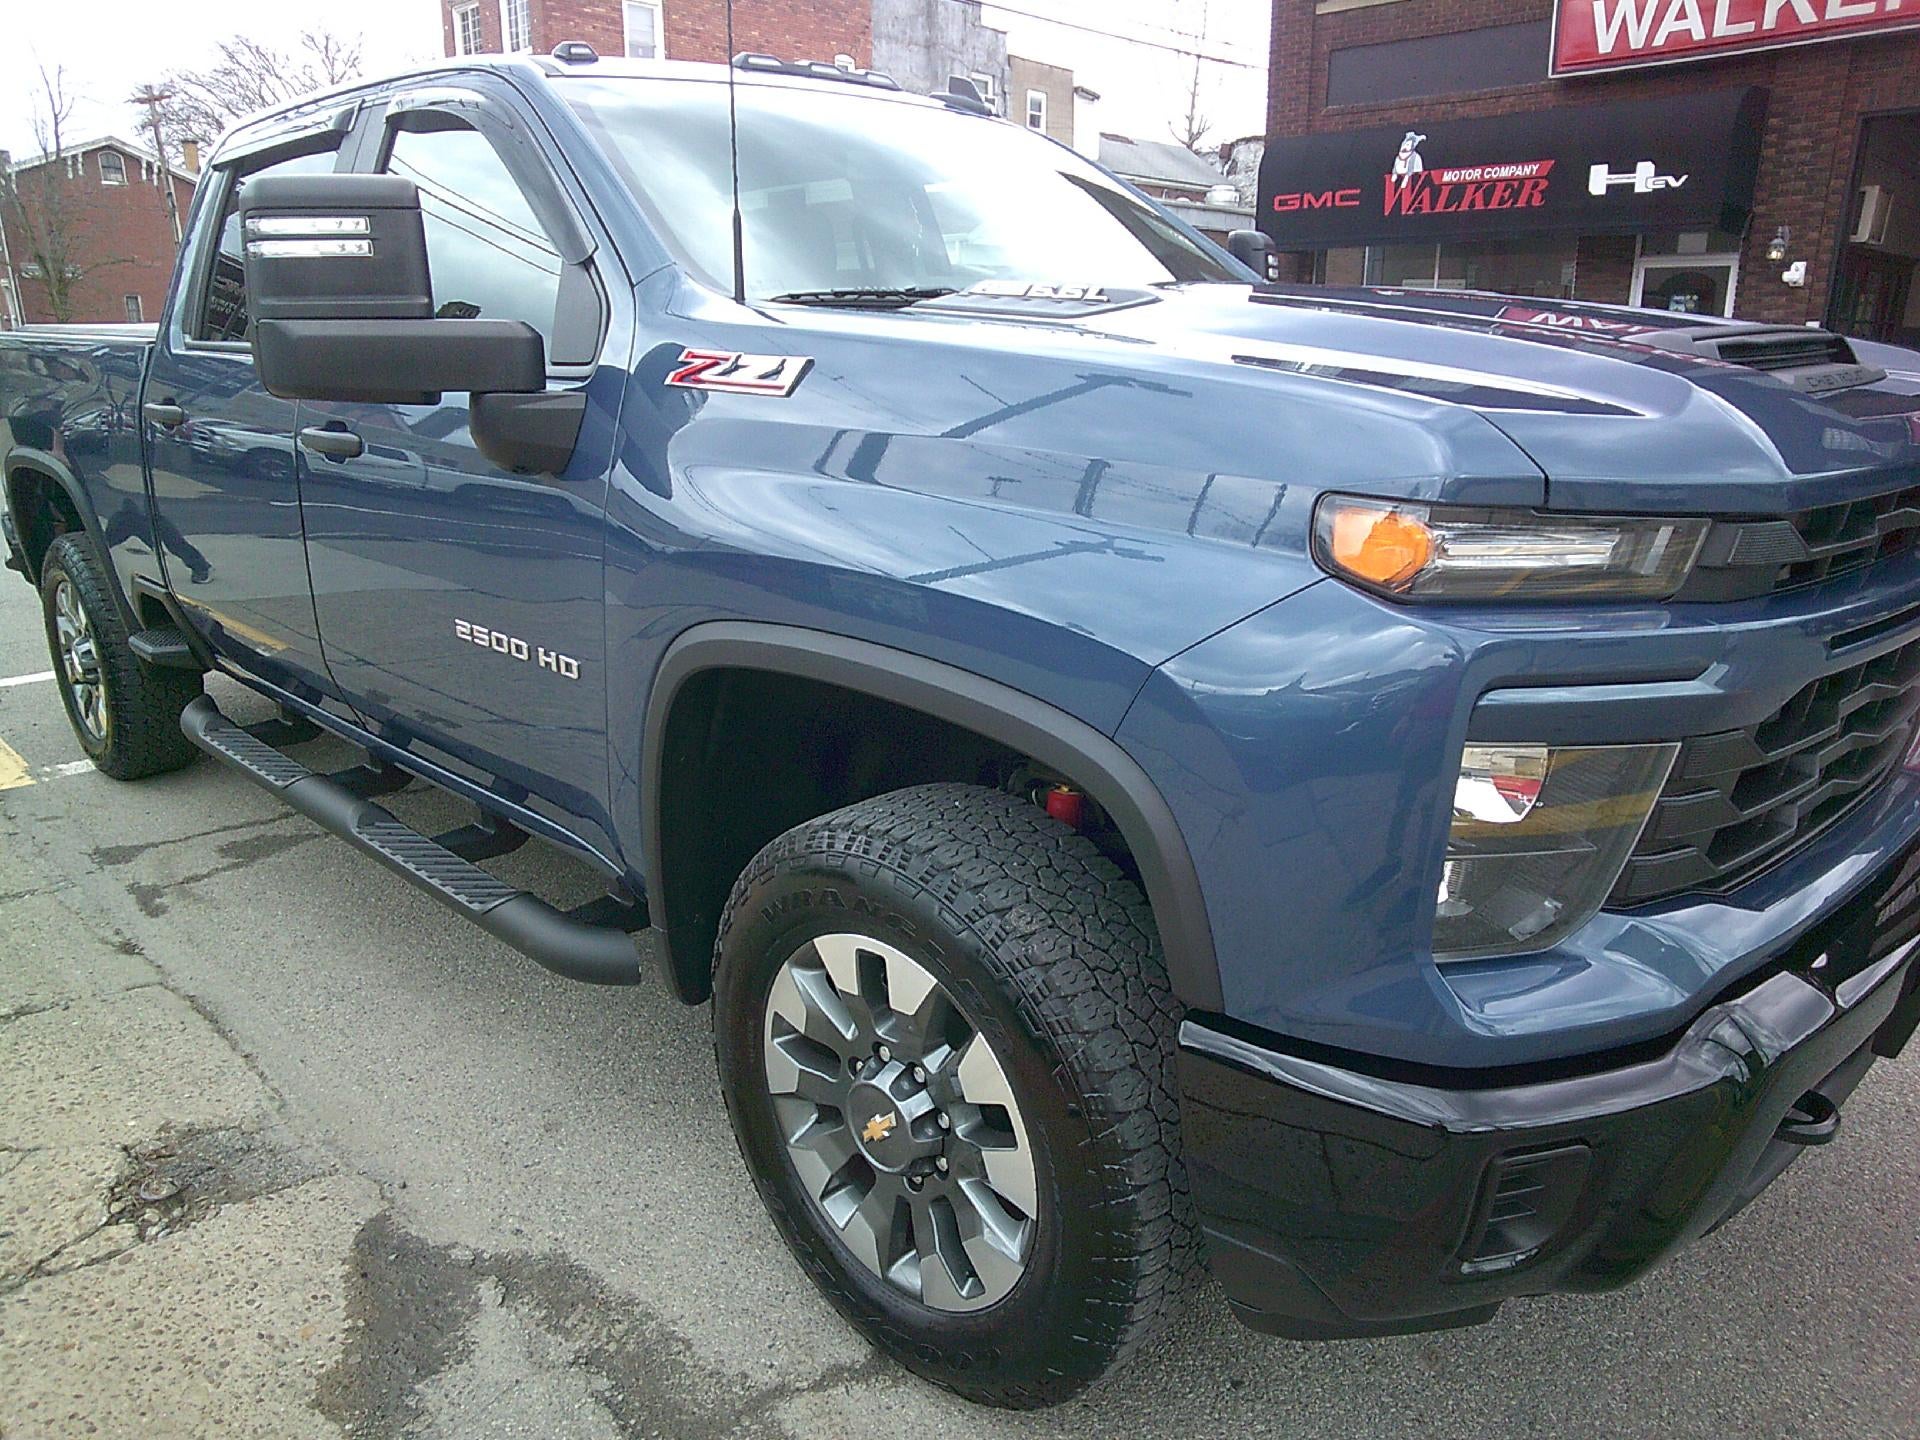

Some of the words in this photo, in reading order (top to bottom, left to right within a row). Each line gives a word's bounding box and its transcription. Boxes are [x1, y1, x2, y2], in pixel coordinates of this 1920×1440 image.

[1592, 0, 1901, 55] WALKE
[1384, 172, 1549, 216] WALKER
[1442, 168, 1482, 182] MOTOR
[1484, 164, 1540, 178] COMPANY
[1273, 189, 1361, 212] GMC
[454, 618, 530, 661] 2500
[537, 646, 580, 680] HD
